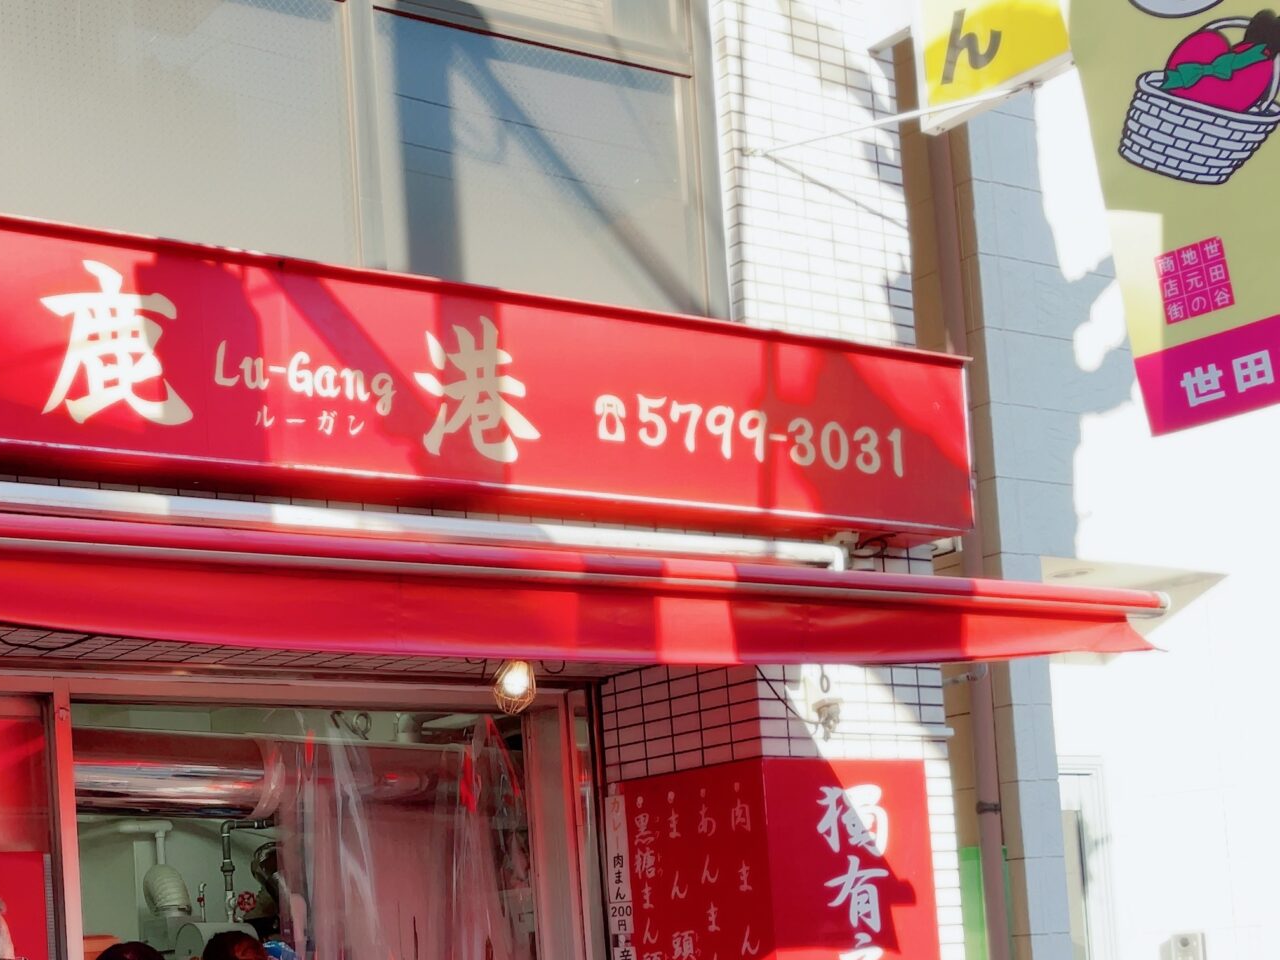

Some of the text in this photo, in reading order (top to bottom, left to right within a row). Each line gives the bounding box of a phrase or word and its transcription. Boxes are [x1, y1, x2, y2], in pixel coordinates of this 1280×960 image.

[1158, 256, 1185, 321] 商店街
[1181, 248, 1208, 313] 地元の
[1203, 240, 1231, 307] 世田谷
[40, 260, 194, 425] 鹿
[214, 340, 397, 416] Lu-Gang
[414, 316, 541, 463] 港
[1180, 349, 1275, 408] 世田
[255, 405, 365, 436] ルーガン
[731, 798, 760, 956] 肉まん
[611, 906, 632, 917] 200
[618, 920, 627, 931] 円
